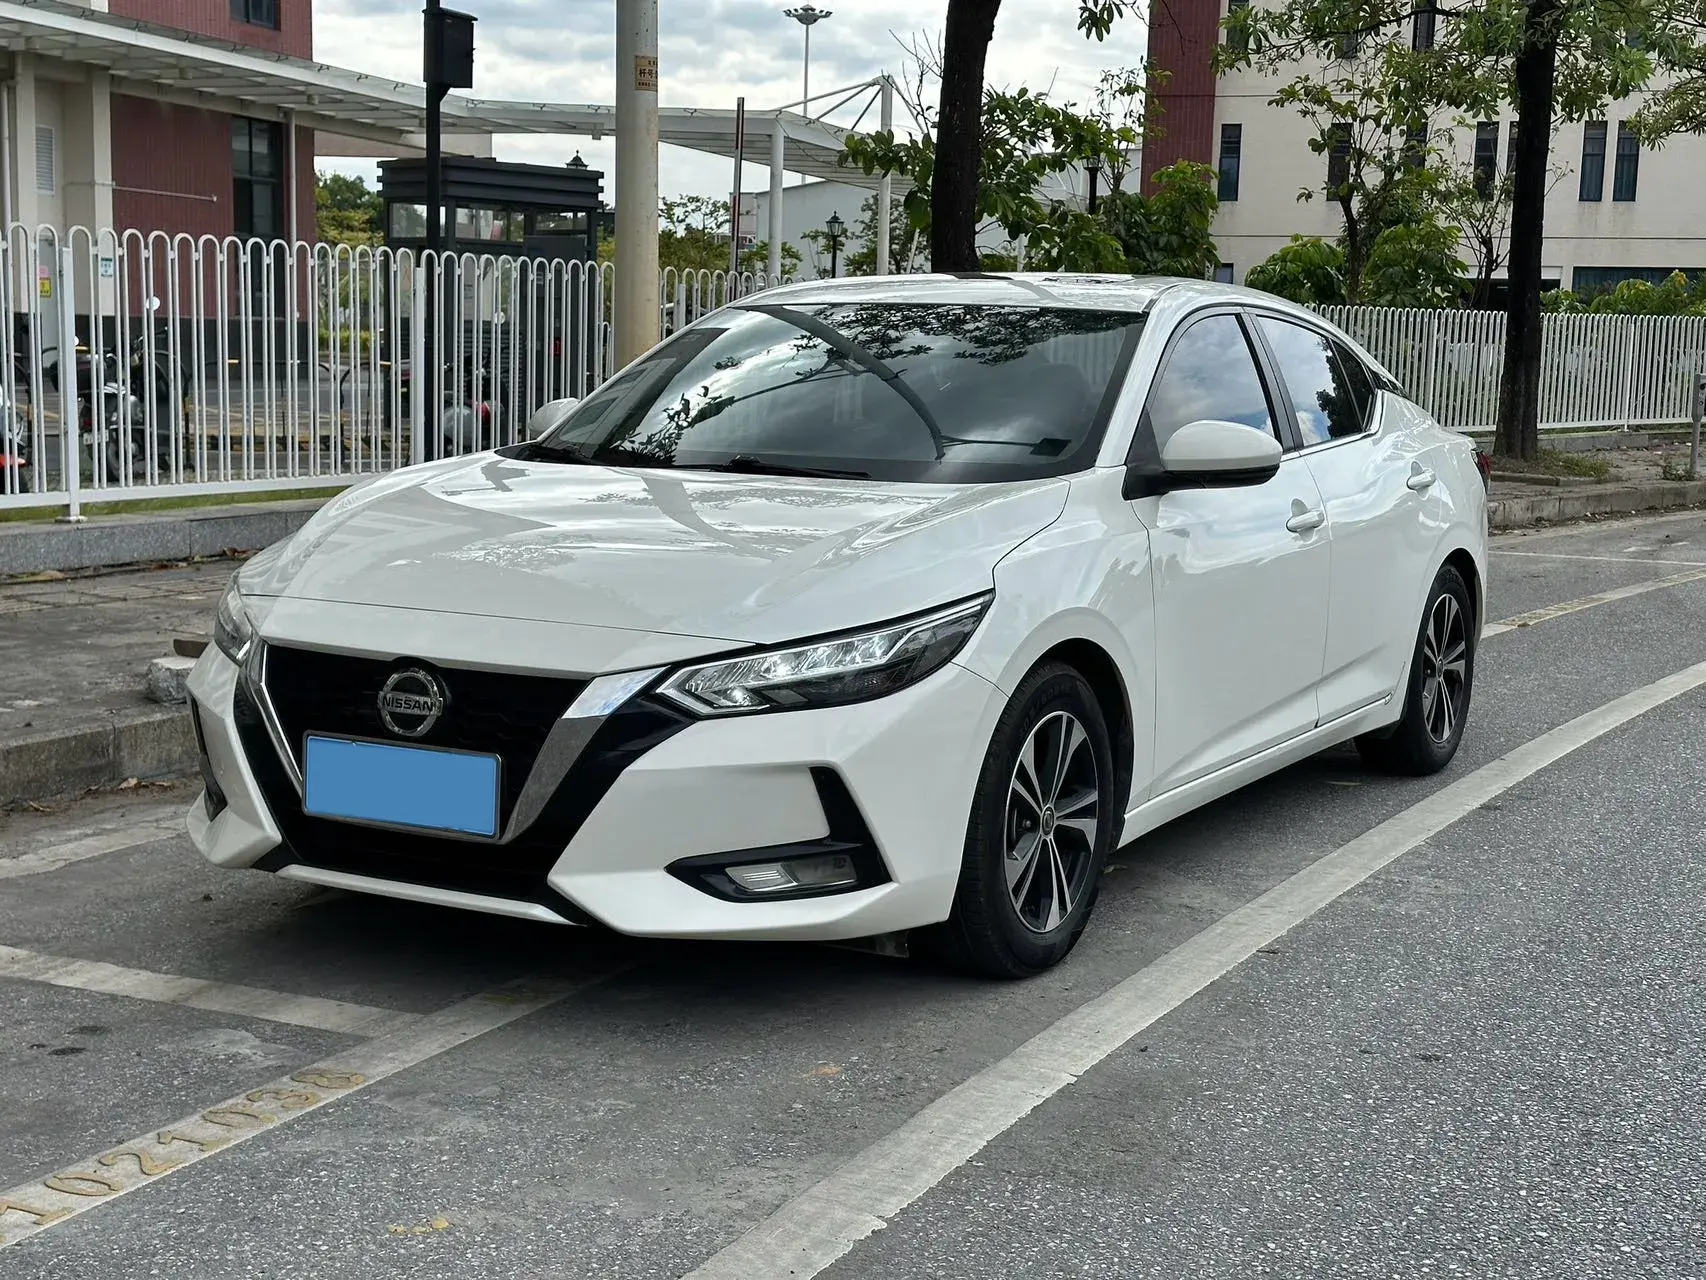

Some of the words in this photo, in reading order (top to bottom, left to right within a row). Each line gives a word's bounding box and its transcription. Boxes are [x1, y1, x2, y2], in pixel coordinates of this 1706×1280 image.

[638, 68, 658, 79] 杆号
[382, 696, 433, 712] NISSAN
[0, 1069, 366, 1244] 1021038
